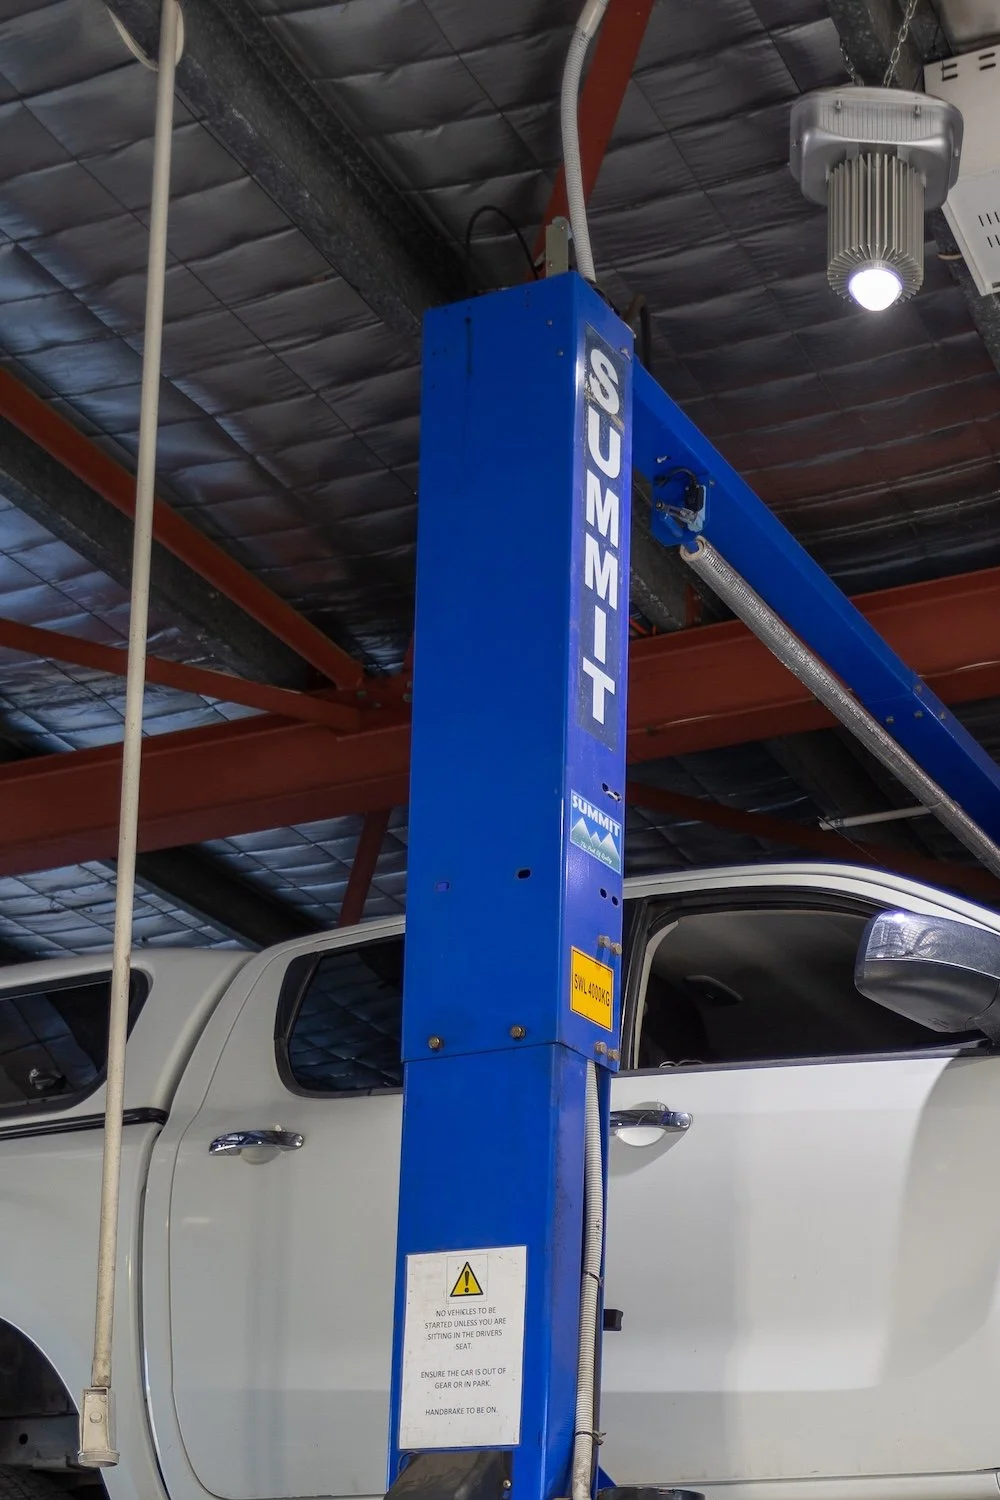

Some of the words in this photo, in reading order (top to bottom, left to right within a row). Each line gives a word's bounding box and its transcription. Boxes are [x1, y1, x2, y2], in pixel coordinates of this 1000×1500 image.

[582, 348, 621, 725] SUMMIT
[572, 795, 620, 837] SUMMIT
[574, 973, 587, 995] SWL
[588, 982, 610, 1007] 4000KG
[447, 1308, 477, 1317] VEHICLES
[478, 1307, 487, 1315] TO
[488, 1306, 496, 1314] BE
[424, 1320, 452, 1329] STARTED
[454, 1319, 478, 1328] UNLESS
[478, 1318, 492, 1327] YOU
[494, 1317, 507, 1326] ARE
[428, 1332, 452, 1341] SITTING
[454, 1331, 461, 1339] IN
[462, 1330, 474, 1339] THE
[476, 1329, 502, 1338] DRIVERS
[455, 1343, 472, 1351] SEAT.
[420, 1370, 446, 1379] ENSURE
[447, 1370, 459, 1378] THE
[460, 1369, 474, 1377] CAR
[475, 1368, 481, 1376] IS
[482, 1368, 496, 1376] OUT
[498, 1367, 507, 1375] OF
[434, 1381, 452, 1389] GEAR
[453, 1381, 463, 1389] OR
[464, 1380, 471, 1388] IN
[472, 1380, 491, 1388] PARK.
[425, 1407, 464, 1416] HANDBRAKE
[466, 1406, 475, 1415] TO
[476, 1406, 485, 1414] BE
[486, 1406, 498, 1414] ON.
